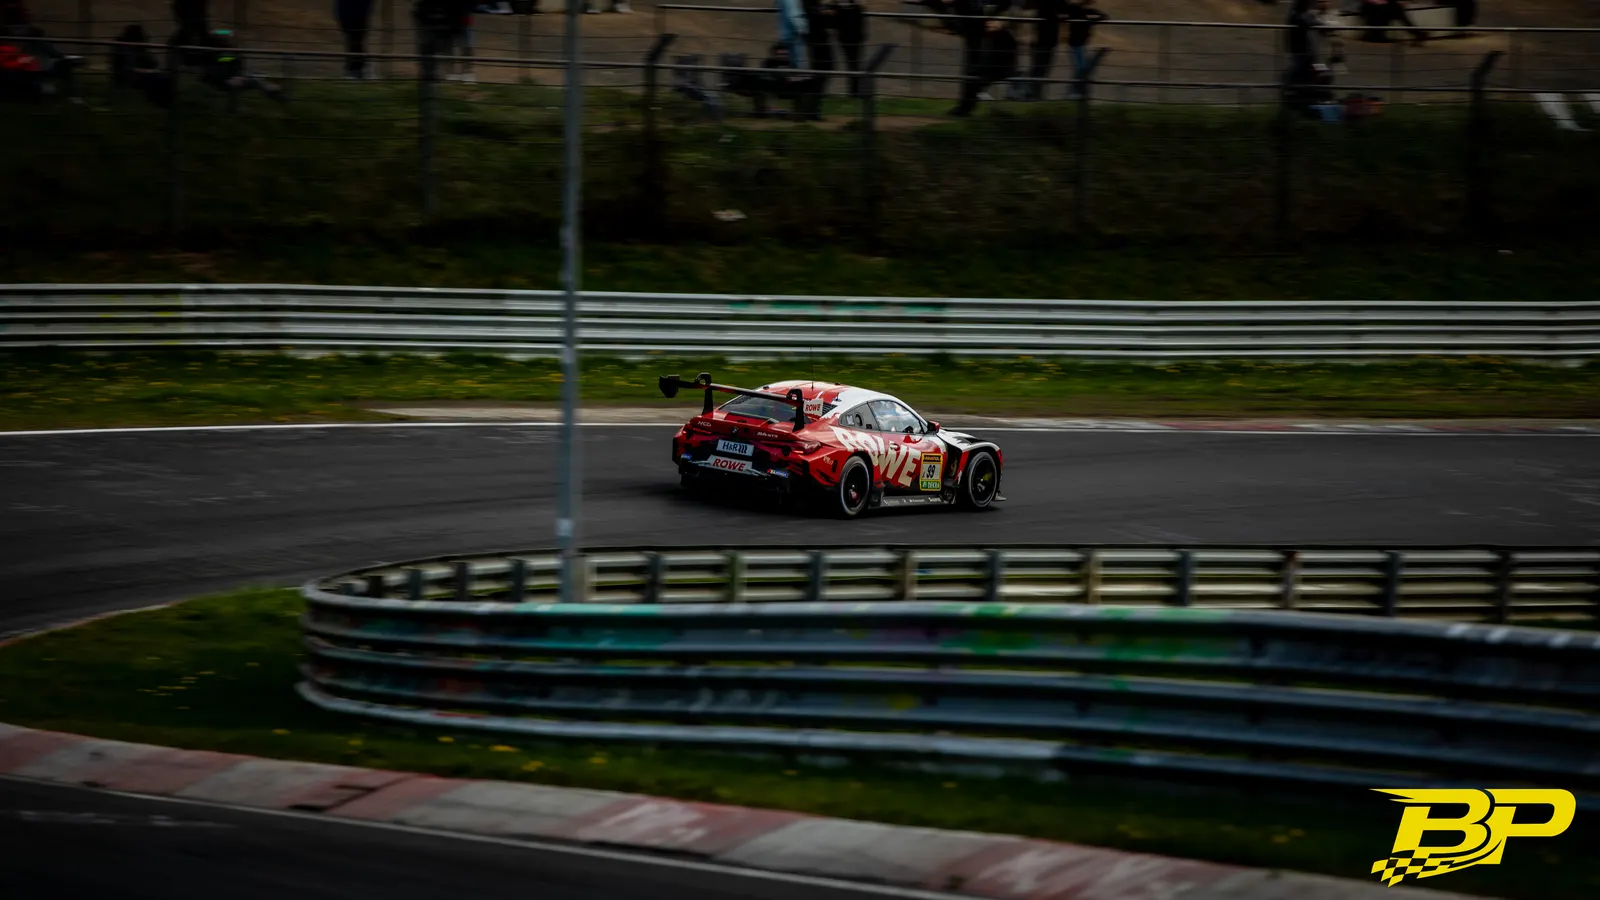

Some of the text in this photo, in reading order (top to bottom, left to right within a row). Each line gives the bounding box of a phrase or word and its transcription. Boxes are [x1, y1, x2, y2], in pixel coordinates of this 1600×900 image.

[805, 403, 821, 412] ROWE
[722, 442, 738, 451] H&R
[828, 425, 921, 488] ROWE
[712, 458, 746, 471] ROWE
